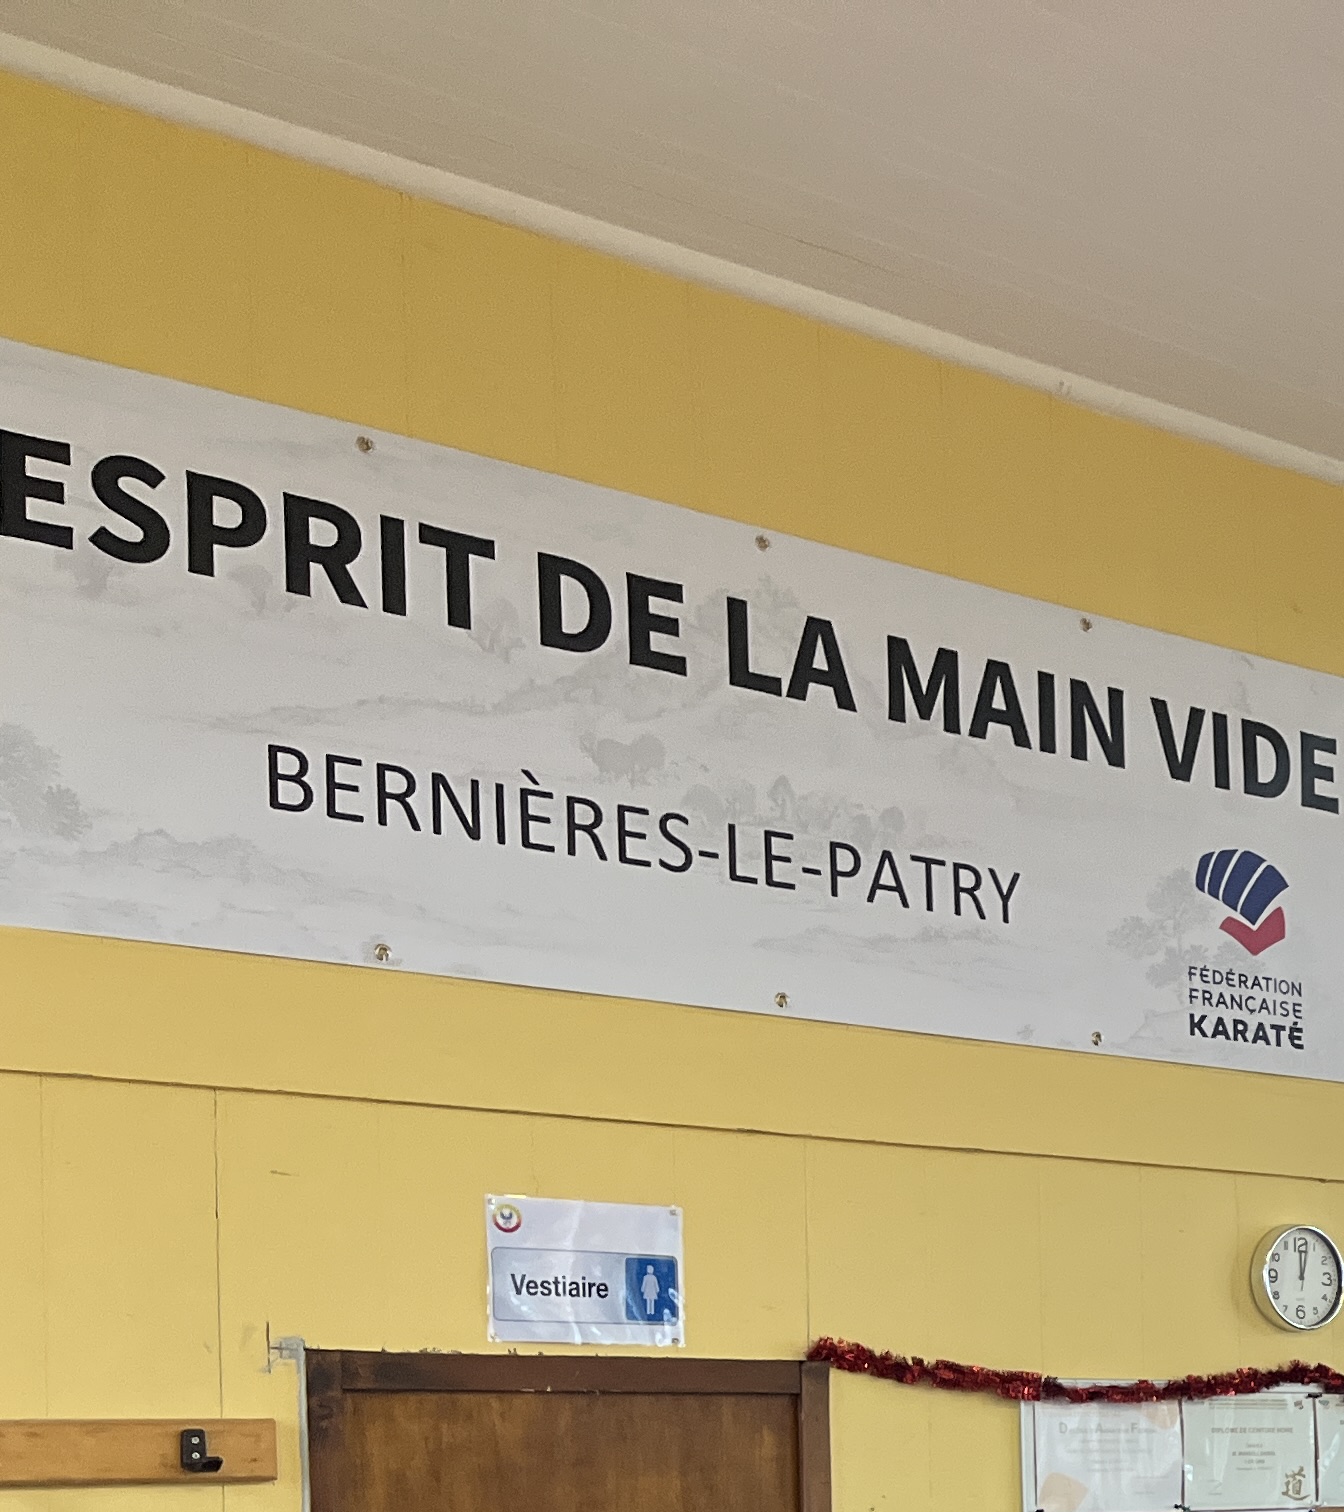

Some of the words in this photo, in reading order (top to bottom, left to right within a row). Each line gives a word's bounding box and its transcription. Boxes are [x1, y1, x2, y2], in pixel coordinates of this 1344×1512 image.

[0, 429, 495, 629] ESPRIT
[538, 552, 687, 676] DE
[727, 596, 857, 713] LA
[886, 635, 1126, 769] MAIN
[1150, 696, 1340, 815] VIDE
[266, 743, 1021, 925] BERNIÈRES-LE-PATRY
[1188, 965, 1302, 997] FÉDÉRATION
[1189, 988, 1303, 1019] FRANÇAISE
[1189, 1013, 1304, 1049] KARATÉ
[1293, 1237, 1308, 1253] 12
[1321, 1256, 1328, 1265] 2
[1268, 1268, 1278, 1283] 9
[1321, 1272, 1332, 1287] 3
[510, 1273, 609, 1299] Vestiaire
[1273, 1291, 1280, 1300] 8
[1282, 1305, 1288, 1313] 7
[1295, 1305, 1306, 1319] 6
[1312, 1307, 1318, 1315] 5
